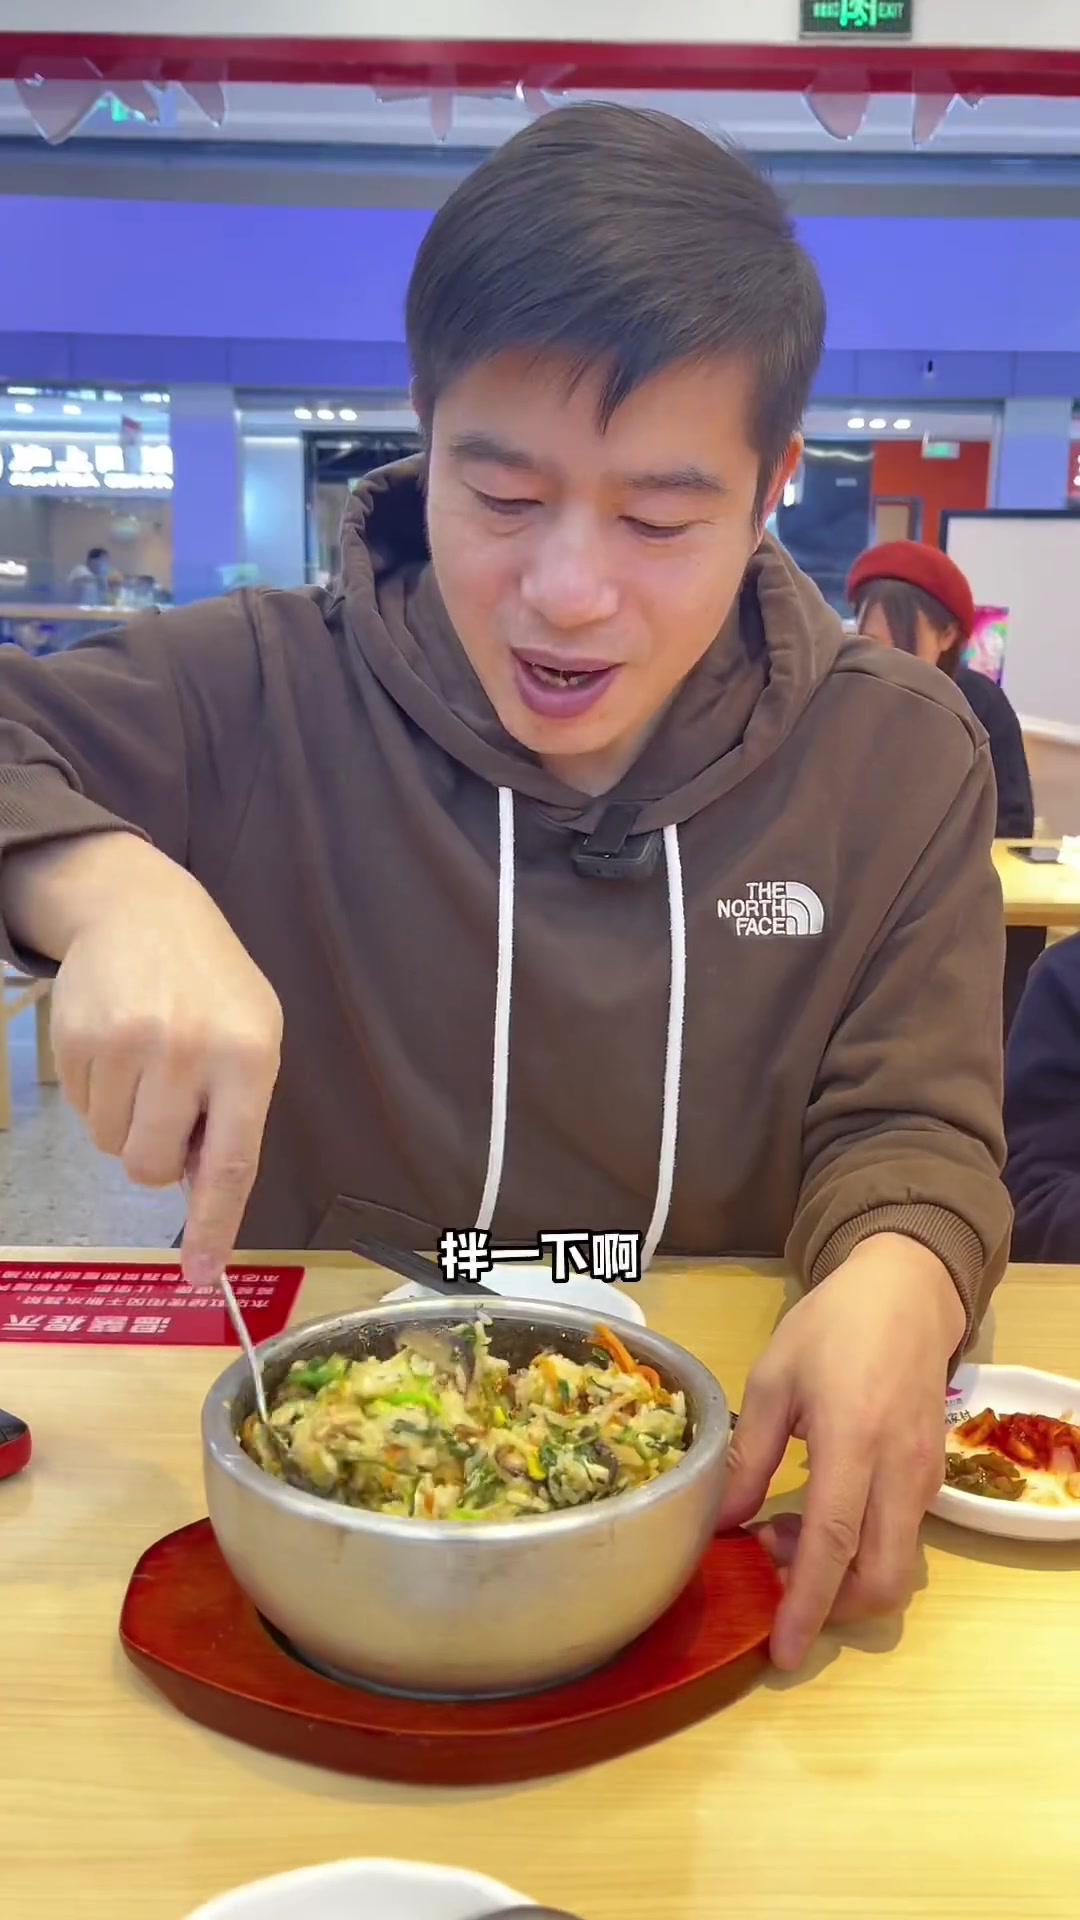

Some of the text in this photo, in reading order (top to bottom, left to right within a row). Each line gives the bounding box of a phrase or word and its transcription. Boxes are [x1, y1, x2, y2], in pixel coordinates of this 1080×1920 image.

[746, 881, 786, 899] THE
[717, 899, 786, 918] NORTH
[736, 917, 786, 936] FACE
[1, 1314, 172, 1334] 温馨提示
